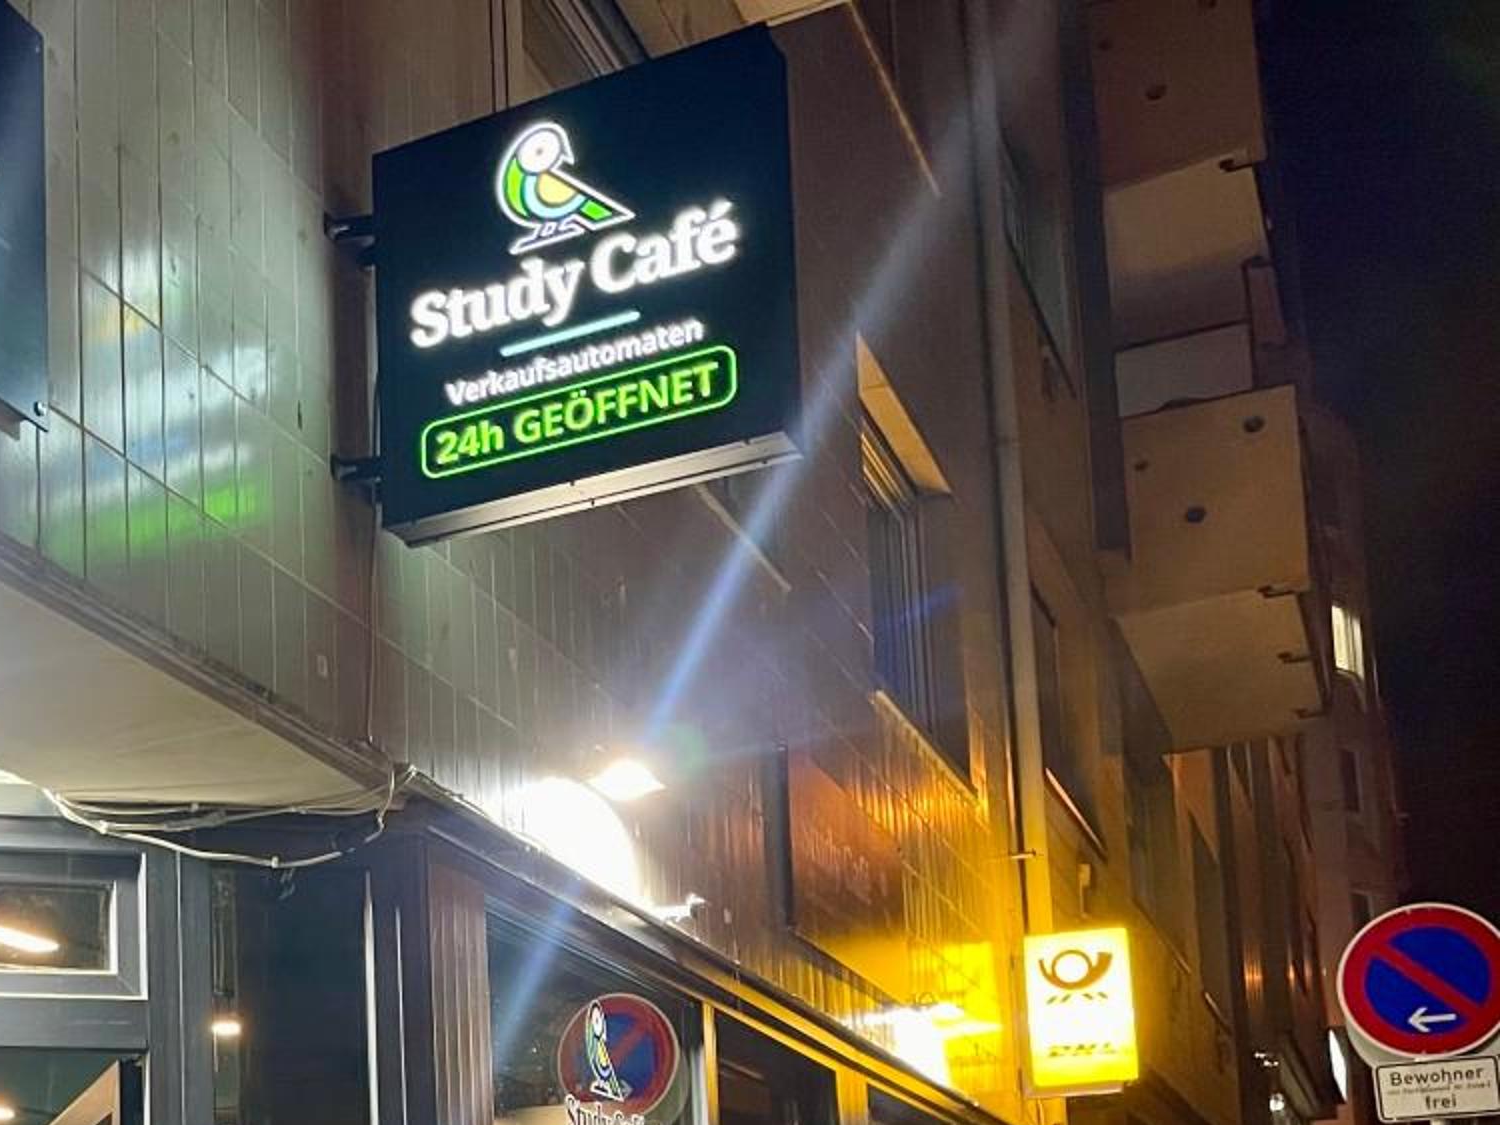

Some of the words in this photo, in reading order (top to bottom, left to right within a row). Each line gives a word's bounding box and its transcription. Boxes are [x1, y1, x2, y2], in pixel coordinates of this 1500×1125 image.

[410, 257, 585, 349] Study
[591, 199, 741, 295] Café
[444, 317, 706, 407] Verkaufsautomaten
[436, 423, 505, 466] 24h
[513, 362, 720, 445] GEÖFFNET
[1390, 1067, 1484, 1086] Bewohner
[1425, 1093, 1457, 1110] frei
